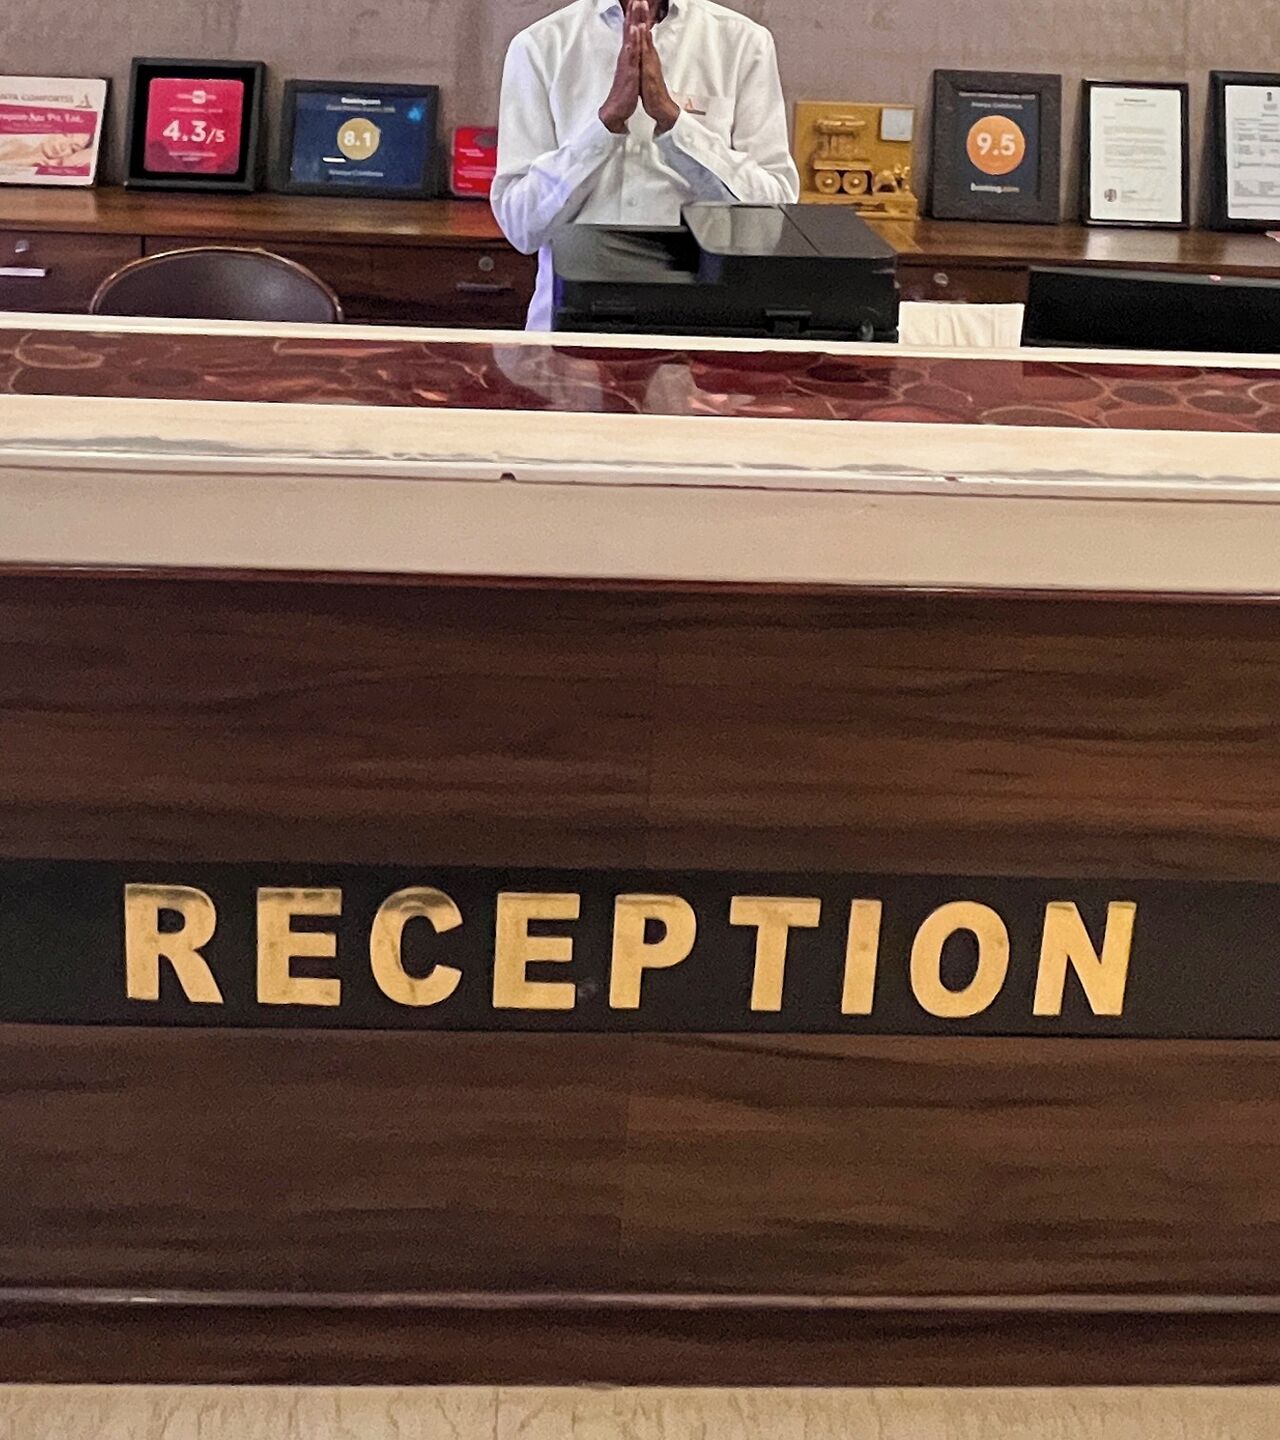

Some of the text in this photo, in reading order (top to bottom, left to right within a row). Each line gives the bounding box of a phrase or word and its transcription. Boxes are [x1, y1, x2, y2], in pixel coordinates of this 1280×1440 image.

[162, 120, 226, 144] 4.3/5
[344, 130, 372, 147] 8.1
[976, 132, 1016, 155] 9.5
[124, 883, 1138, 1019] RECEPTION
